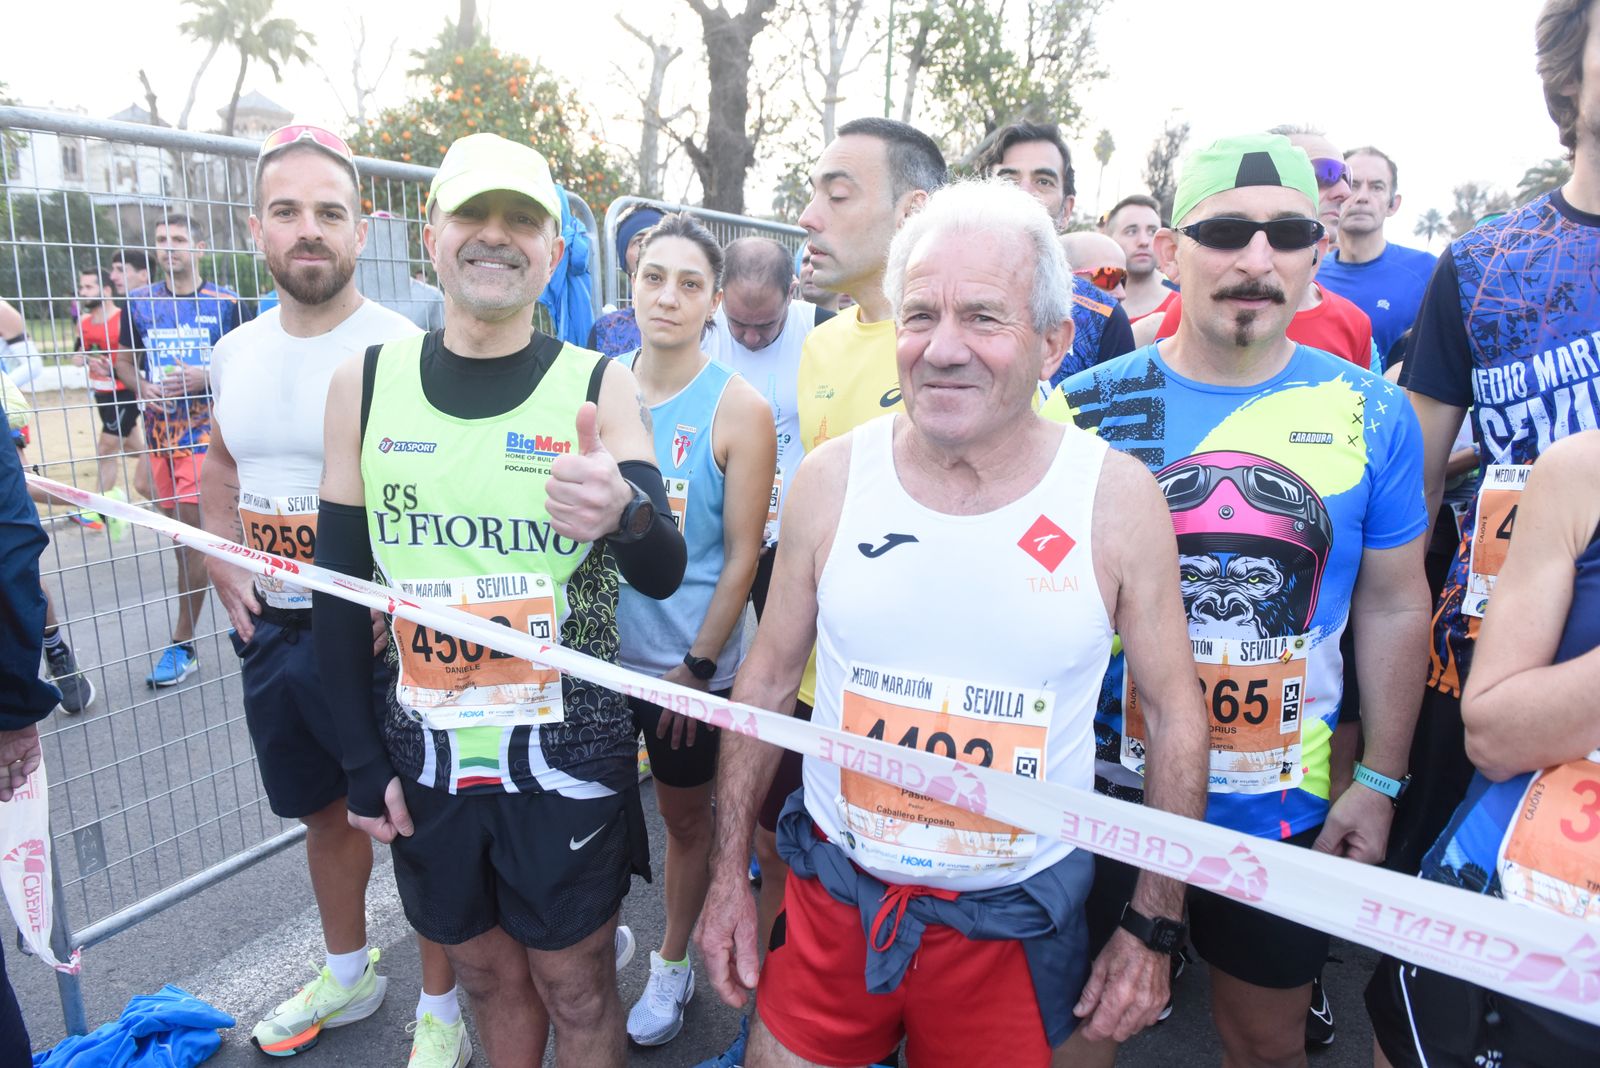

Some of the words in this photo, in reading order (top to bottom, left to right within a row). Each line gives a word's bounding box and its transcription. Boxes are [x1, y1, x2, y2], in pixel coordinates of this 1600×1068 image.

[406, 442, 436, 452] SPORT
[506, 431, 571, 454] BigMat
[505, 465, 537, 474] FOCARDI
[1494, 469, 1516, 482] MEDIO
[383, 483, 418, 523] gs
[251, 521, 316, 559] 5259
[406, 513, 580, 556] FIORINO
[415, 580, 452, 598] MARATÓN
[476, 576, 528, 599] SEVILLA
[445, 664, 481, 673] DANIELE
[852, 667, 879, 689] MEDIO
[881, 673, 933, 700] MARATÓN
[963, 685, 1025, 719] SEVILLA
[459, 710, 485, 718] HOKA
[876, 804, 916, 821] Caballero
[917, 814, 955, 828] Exposito
[901, 855, 933, 868] HOKA
